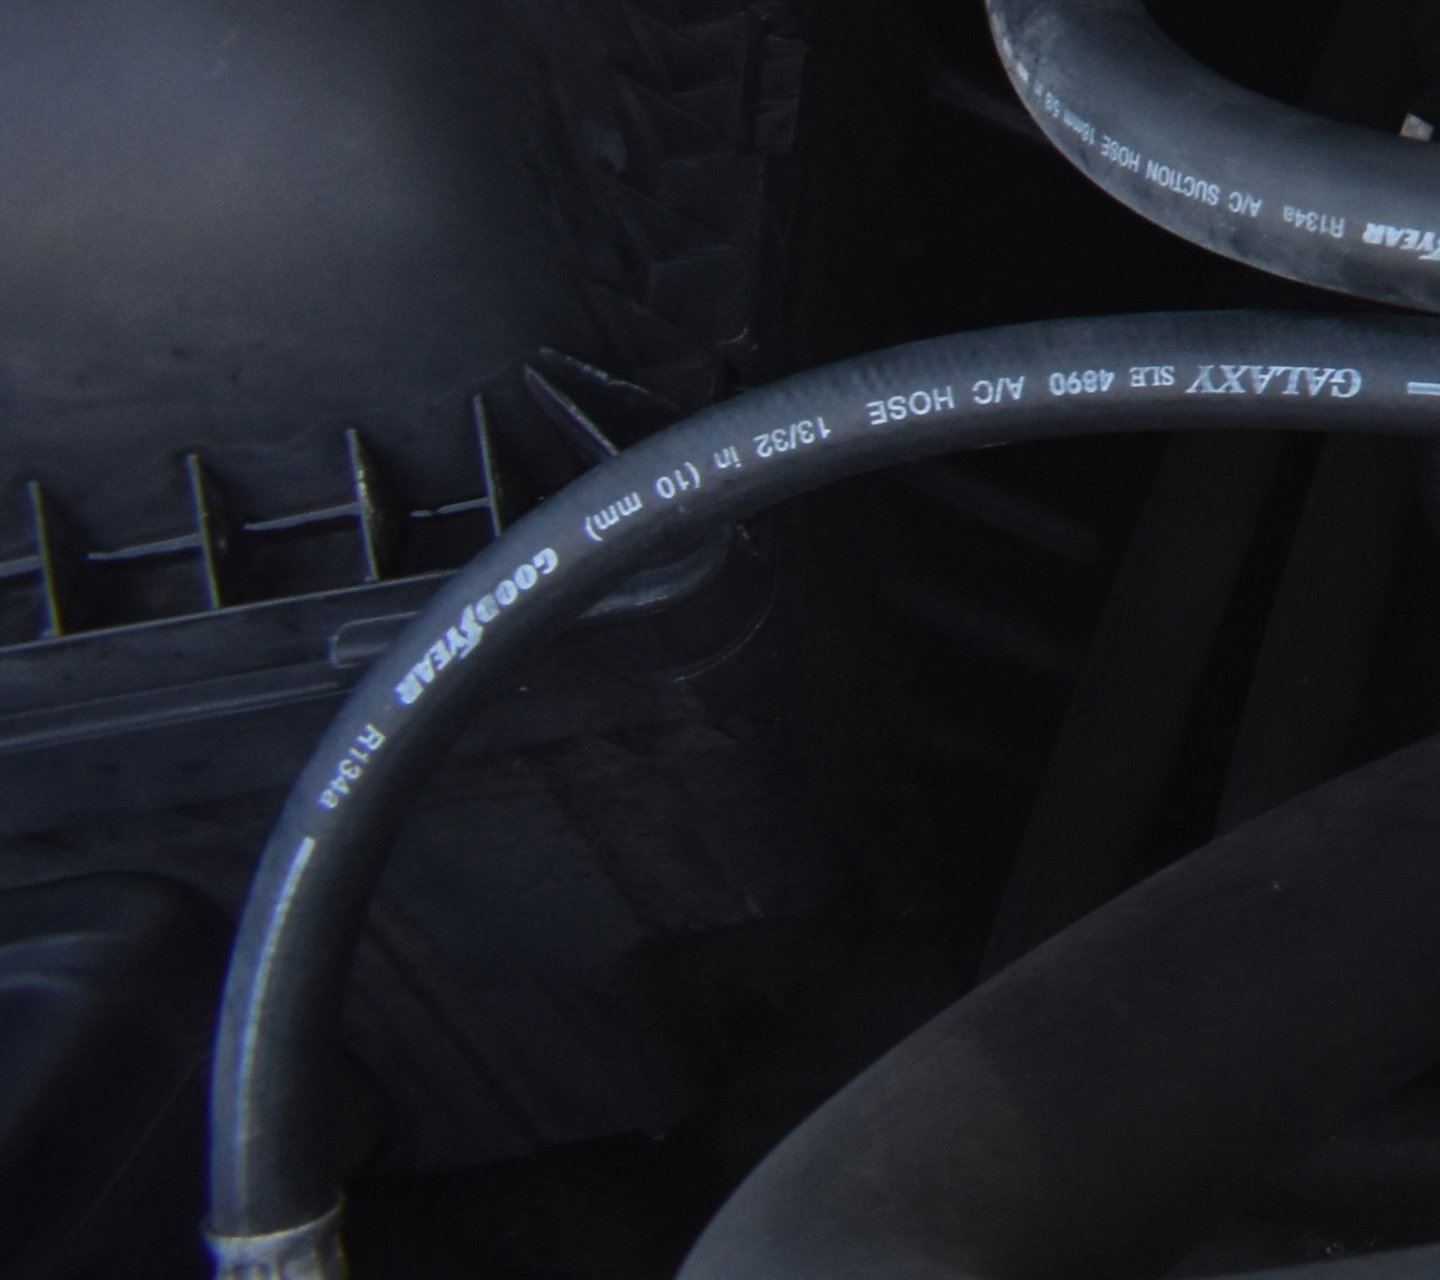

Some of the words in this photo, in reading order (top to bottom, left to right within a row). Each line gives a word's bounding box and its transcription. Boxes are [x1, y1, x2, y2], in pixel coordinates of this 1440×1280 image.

[1099, 134, 1140, 172] HOSE
[1143, 158, 1220, 205] SUCTION
[1228, 190, 1263, 216] A/C
[1282, 203, 1346, 239] R134a
[971, 374, 1026, 406] A/C
[1047, 367, 1115, 398] 4890
[1128, 363, 1175, 388] SLE
[1185, 363, 1362, 399] GALAXY
[863, 384, 954, 427] HOSE
[751, 413, 832, 459] 13/32
[712, 443, 740, 471] in
[653, 459, 701, 500] (10
[581, 490, 643, 543] mm)
[390, 545, 558, 706] GOODYEAR
[316, 721, 385, 812] R134a
